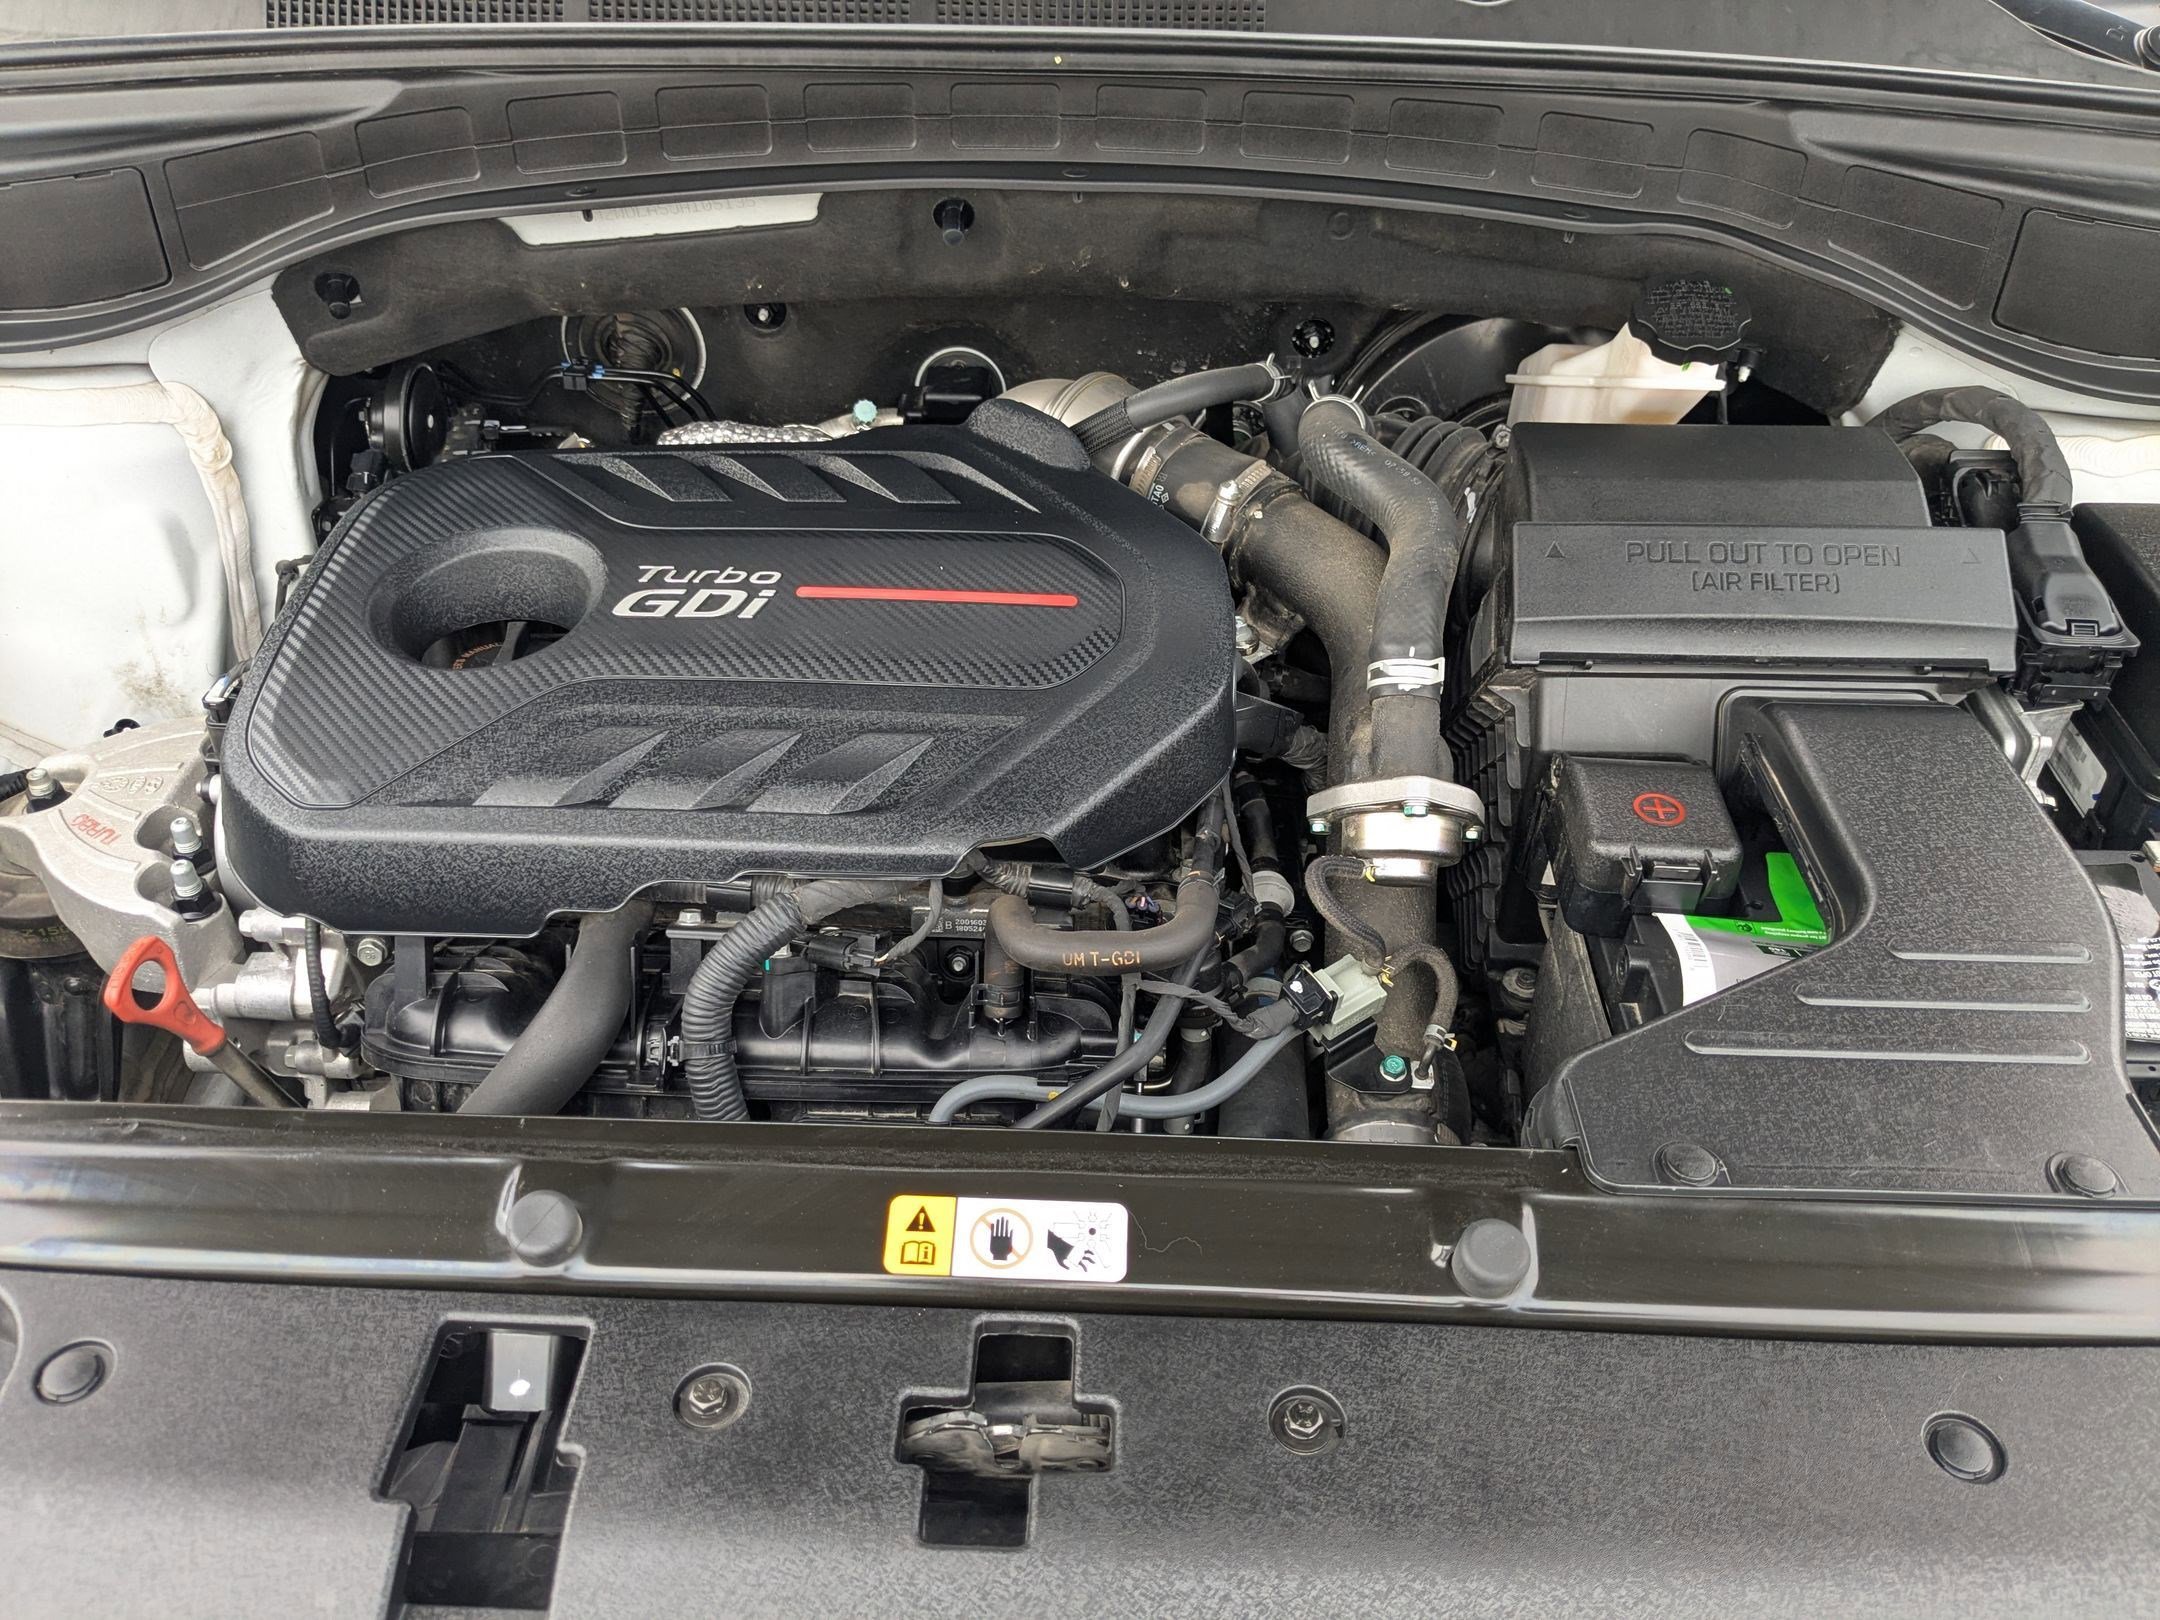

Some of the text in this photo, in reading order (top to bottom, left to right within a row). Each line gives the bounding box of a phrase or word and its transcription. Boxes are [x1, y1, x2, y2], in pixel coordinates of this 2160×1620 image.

[1624, 540, 1902, 568] PULL OUT TO OPEN
[637, 565, 783, 585] Turbo
[611, 588, 778, 619] GDi
[944, 920, 953, 930] B
[1062, 950, 1141, 967] UM T-GDI
